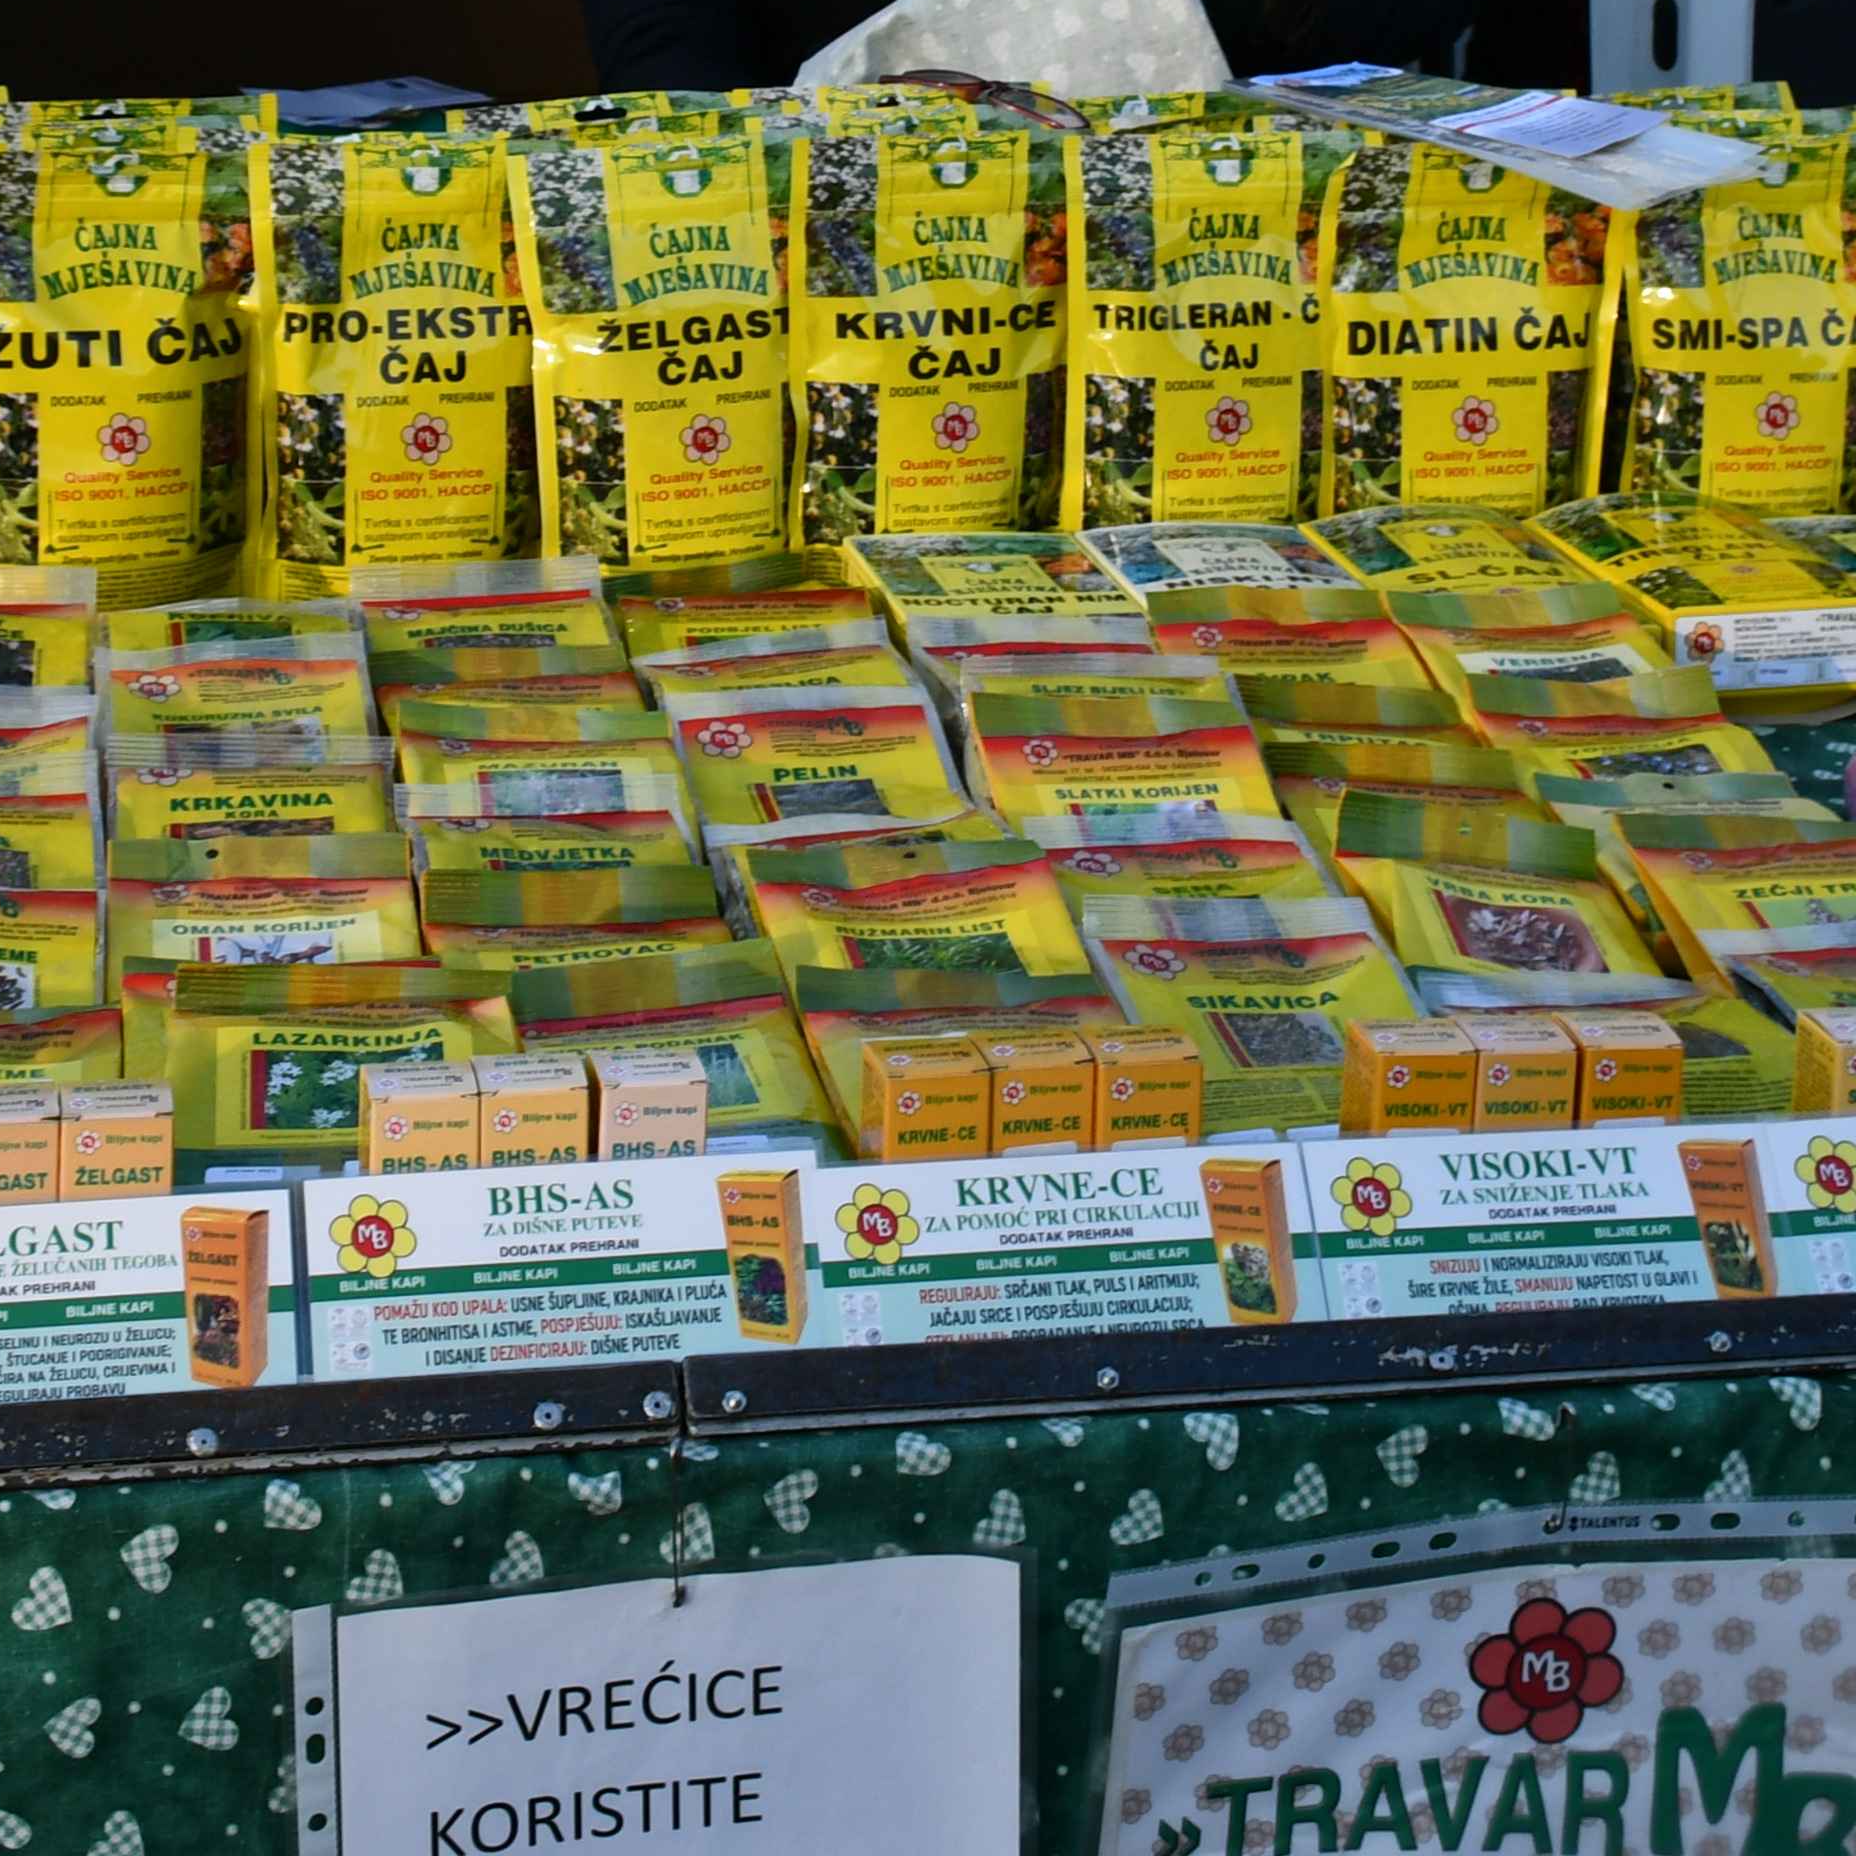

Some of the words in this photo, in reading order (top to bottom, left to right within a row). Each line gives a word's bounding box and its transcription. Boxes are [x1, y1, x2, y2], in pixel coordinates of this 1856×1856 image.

[382, 218, 459, 252] ČAJNA
[350, 253, 495, 299] MJEŠAVINA
[835, 302, 1055, 339] KRVNI-CE
[1094, 304, 1274, 332] TRIGLERAN
[148, 316, 241, 363] ČAJ
[597, 311, 789, 353] ŽELGAST
[1349, 316, 1499, 356] DIATIN
[1653, 315, 1809, 351] SMI-SPA
[379, 345, 467, 385] ČAJ
[657, 346, 743, 384] ČAJ
[909, 343, 1001, 382] ČAJ
[1200, 341, 1259, 371] ČAJ
[370, 469, 426, 483] Quality
[430, 466, 484, 480] Service
[361, 489, 385, 503] ISO
[437, 482, 492, 497] HACCP
[497, 621, 568, 636] DUŠICA
[773, 764, 858, 783] PELIN
[169, 791, 333, 811] KRKAVINA
[1055, 785, 1120, 799] SLATKI
[1126, 782, 1218, 798] KORIJEN
[224, 808, 280, 819] KORA
[480, 846, 635, 863] MEDVJETKA
[1503, 891, 1573, 906] KORA
[1732, 882, 1814, 900] ZEČJI
[172, 922, 238, 936] OMAN
[245, 917, 355, 934] KORIJEN
[1187, 991, 1340, 1009] SIKAVICA
[252, 1025, 441, 1047] LAZARKINJA
[1485, 1099, 1568, 1116] VISOKI-VT
[897, 1124, 977, 1145] KRVNE-CE
[1441, 1146, 1636, 1180] VISOKI-VT
[488, 1178, 634, 1217] BHS-AS
[956, 1168, 1164, 1206] KRVNE-CE
[1442, 1189, 1464, 1203] ZA
[1470, 1183, 1570, 1203] SNIŽENJE
[1576, 1180, 1649, 1197] TLAKA
[483, 1222, 505, 1236] ZA
[510, 1215, 562, 1234] DIŠNE
[567, 1214, 643, 1232] PUTEVE
[925, 1217, 949, 1233] ZA
[956, 1206, 1028, 1231] POMOĆ
[1035, 1209, 1067, 1227] PRI
[1073, 1201, 1199, 1225] CIRKULACIJI
[10, 1256, 107, 1277] ŽELUČANIH
[112, 1253, 179, 1270] TEGOBA
[1579, 1514, 1640, 1530] TALENTUS
[425, 1660, 784, 1750] >>VREĆICE
[430, 1772, 763, 1856] KORISTITE
